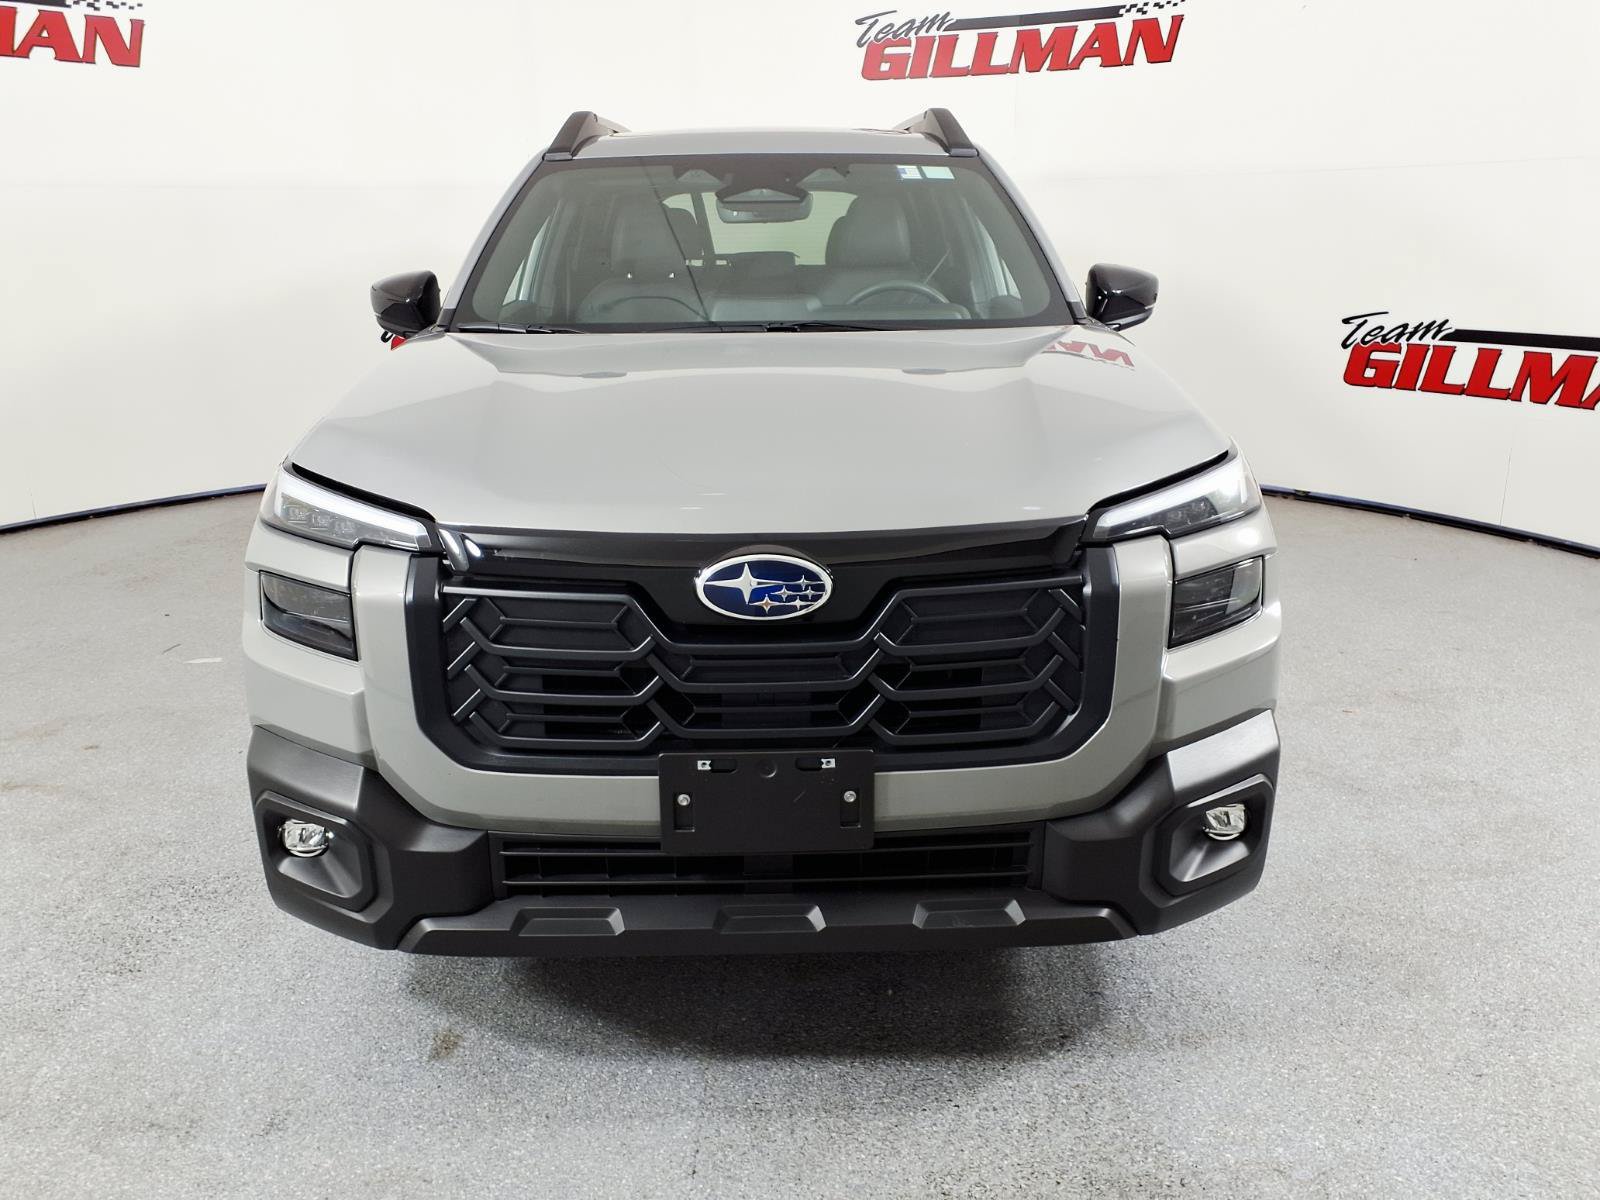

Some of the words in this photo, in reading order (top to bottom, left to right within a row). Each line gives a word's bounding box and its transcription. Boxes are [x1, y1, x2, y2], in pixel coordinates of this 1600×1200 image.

[0, 6, 145, 68] AN
[855, 10, 956, 48] Team
[861, 14, 1185, 81] GILLMAN
[1341, 311, 1452, 350] Team
[1343, 341, 1600, 410] GILLM
